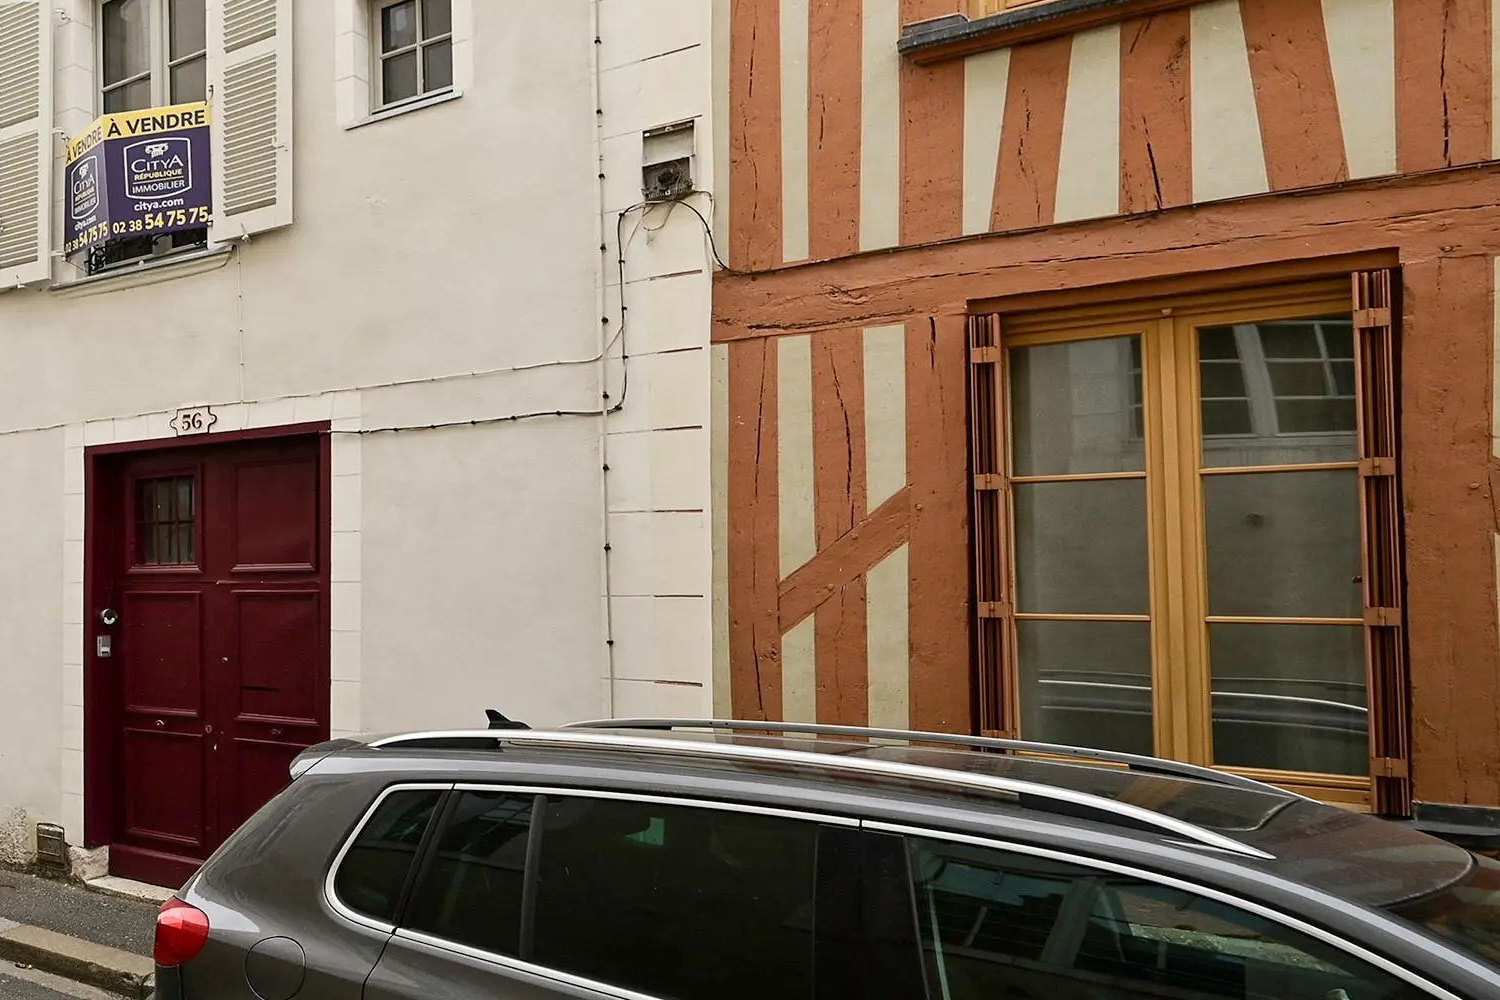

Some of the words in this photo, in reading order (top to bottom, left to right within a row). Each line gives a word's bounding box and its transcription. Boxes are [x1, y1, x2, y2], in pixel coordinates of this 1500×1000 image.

[107, 118, 122, 137] À
[126, 109, 205, 134] VENDRE
[72, 126, 102, 157] VENDRE
[131, 154, 184, 173] CITYA
[134, 168, 183, 181] RÉPUBLIQUE
[132, 180, 185, 194] IMMOBILIER
[134, 198, 184, 212] citya.com
[112, 221, 127, 234] 02
[128, 219, 143, 232] 38
[144, 212, 165, 230] 54
[167, 209, 186, 227] 75
[189, 206, 209, 224] 75
[78, 230, 88, 248] 54
[88, 225, 98, 243] 75
[98, 221, 109, 239] 75
[182, 412, 202, 431] 56
